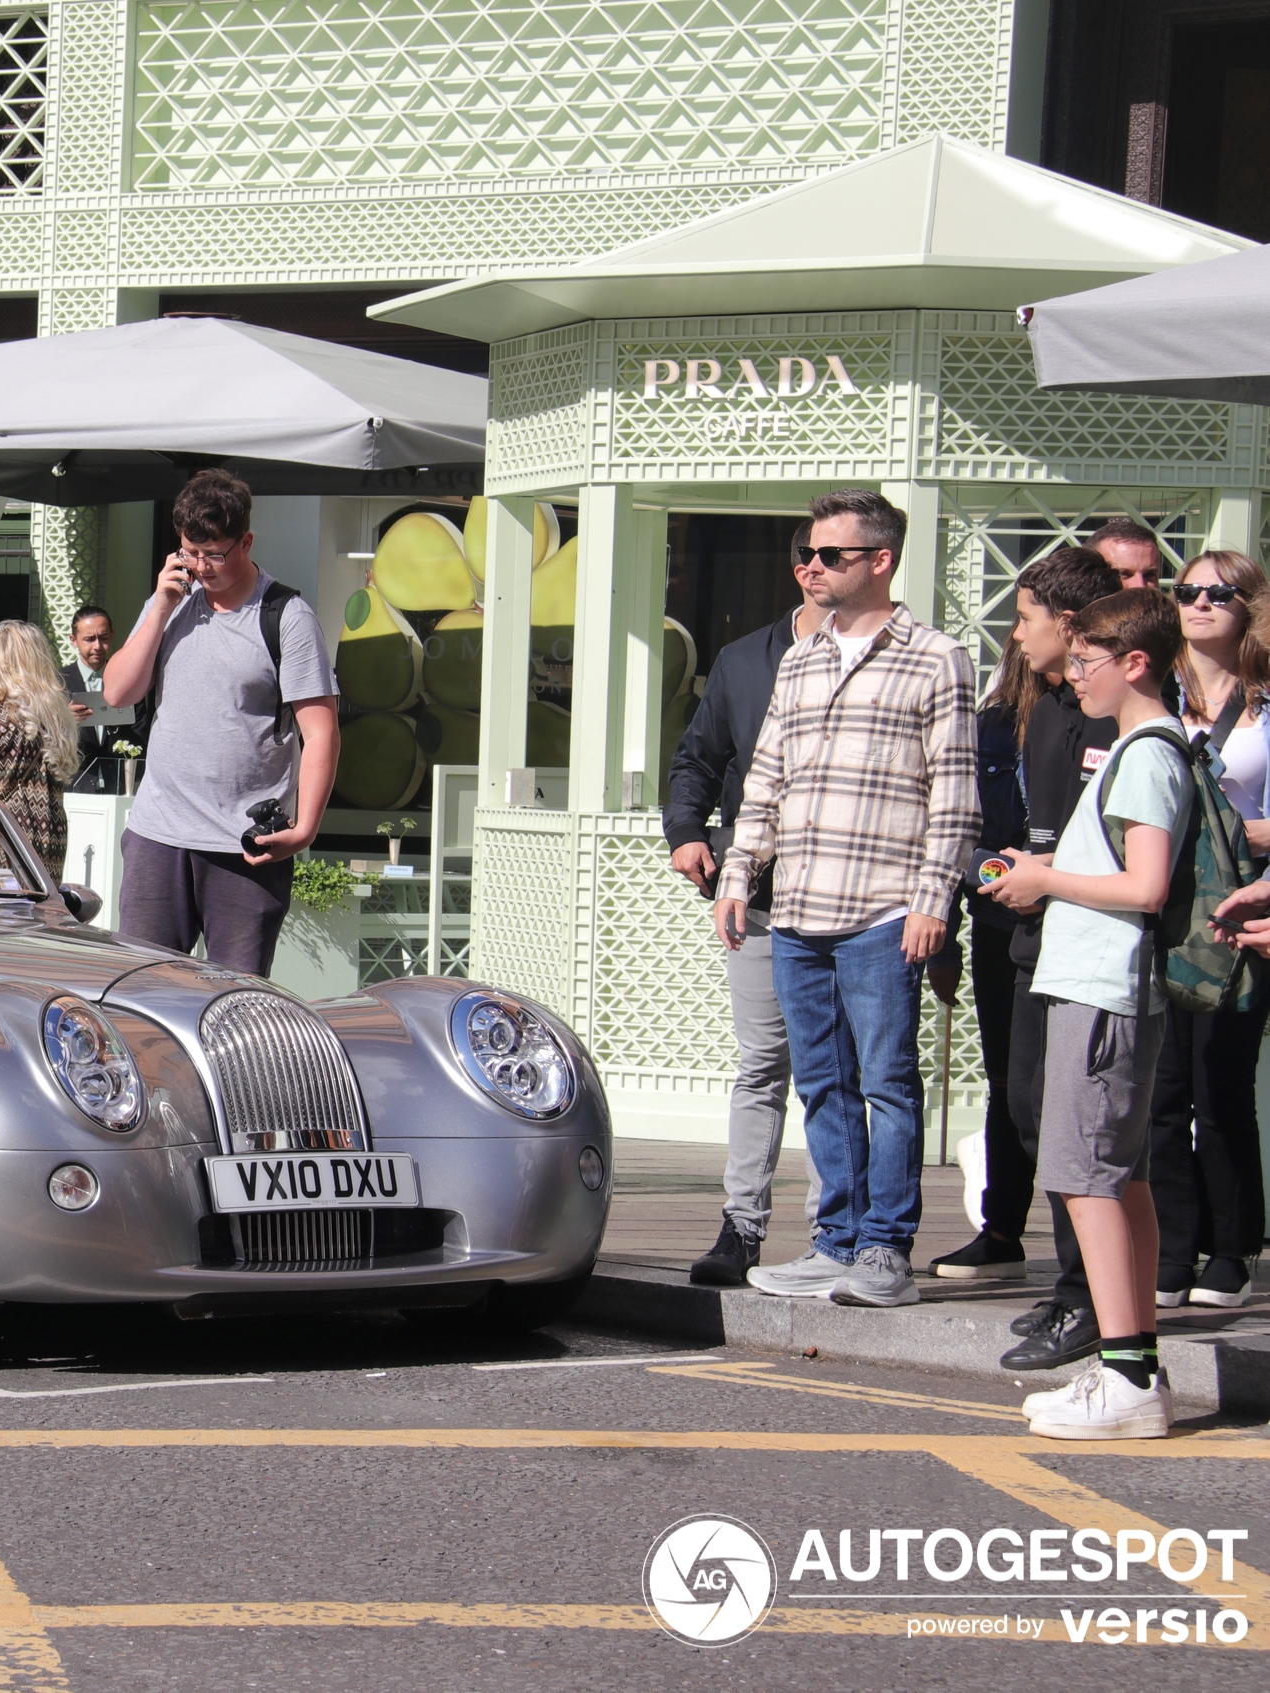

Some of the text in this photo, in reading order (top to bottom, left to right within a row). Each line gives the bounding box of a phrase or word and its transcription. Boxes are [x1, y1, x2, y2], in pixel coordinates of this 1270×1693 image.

[642, 355, 859, 400] PRADA
[236, 1158, 398, 1201] VX10 DXU
